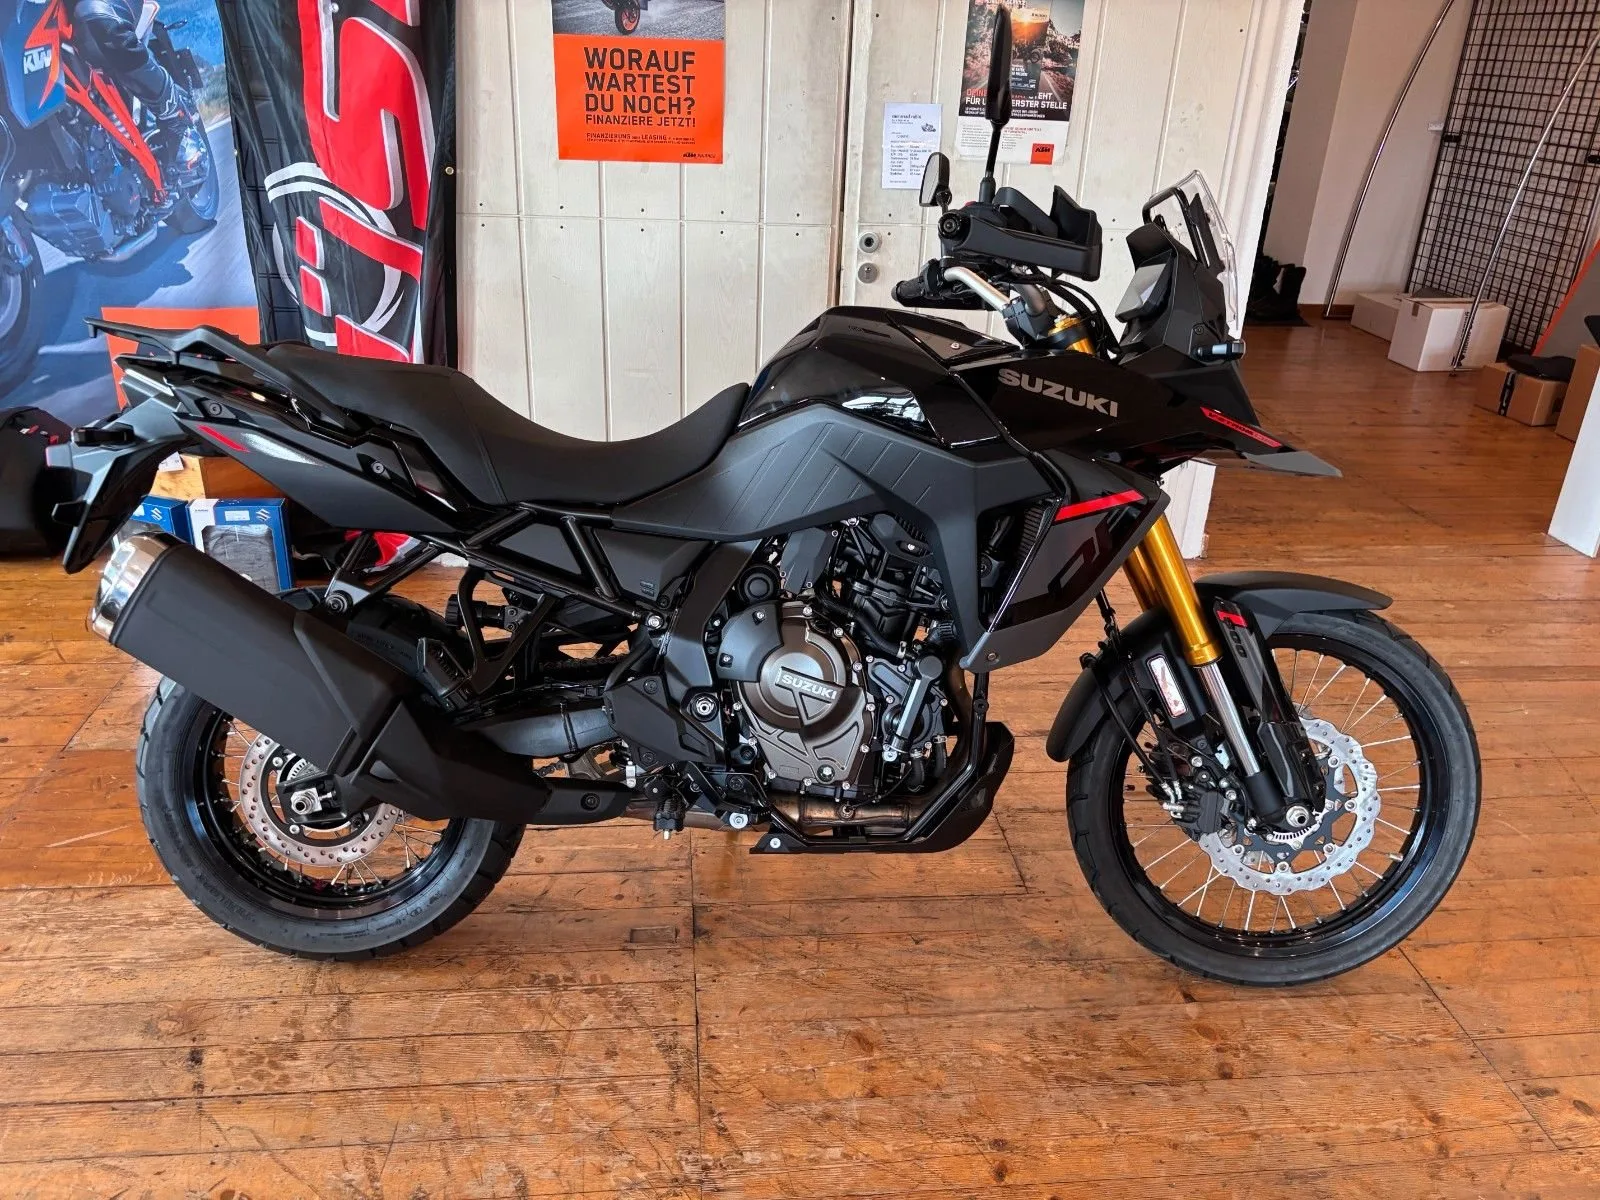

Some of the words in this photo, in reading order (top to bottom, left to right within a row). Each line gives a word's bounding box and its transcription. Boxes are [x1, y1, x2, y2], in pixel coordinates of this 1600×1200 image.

[584, 47, 695, 72] WORAUF
[584, 72, 695, 94] WARTEST
[585, 94, 613, 112] DU
[623, 95, 695, 115] NOCH?
[965, 96, 981, 104] FÜR
[1011, 100, 1039, 108] ERSTER
[1041, 101, 1067, 110] STELLE
[586, 114, 653, 126] FINANZIERE
[657, 117, 695, 127] JETZT!
[998, 368, 1118, 418] SUZUKI
[782, 673, 837, 699] SUZUKI
